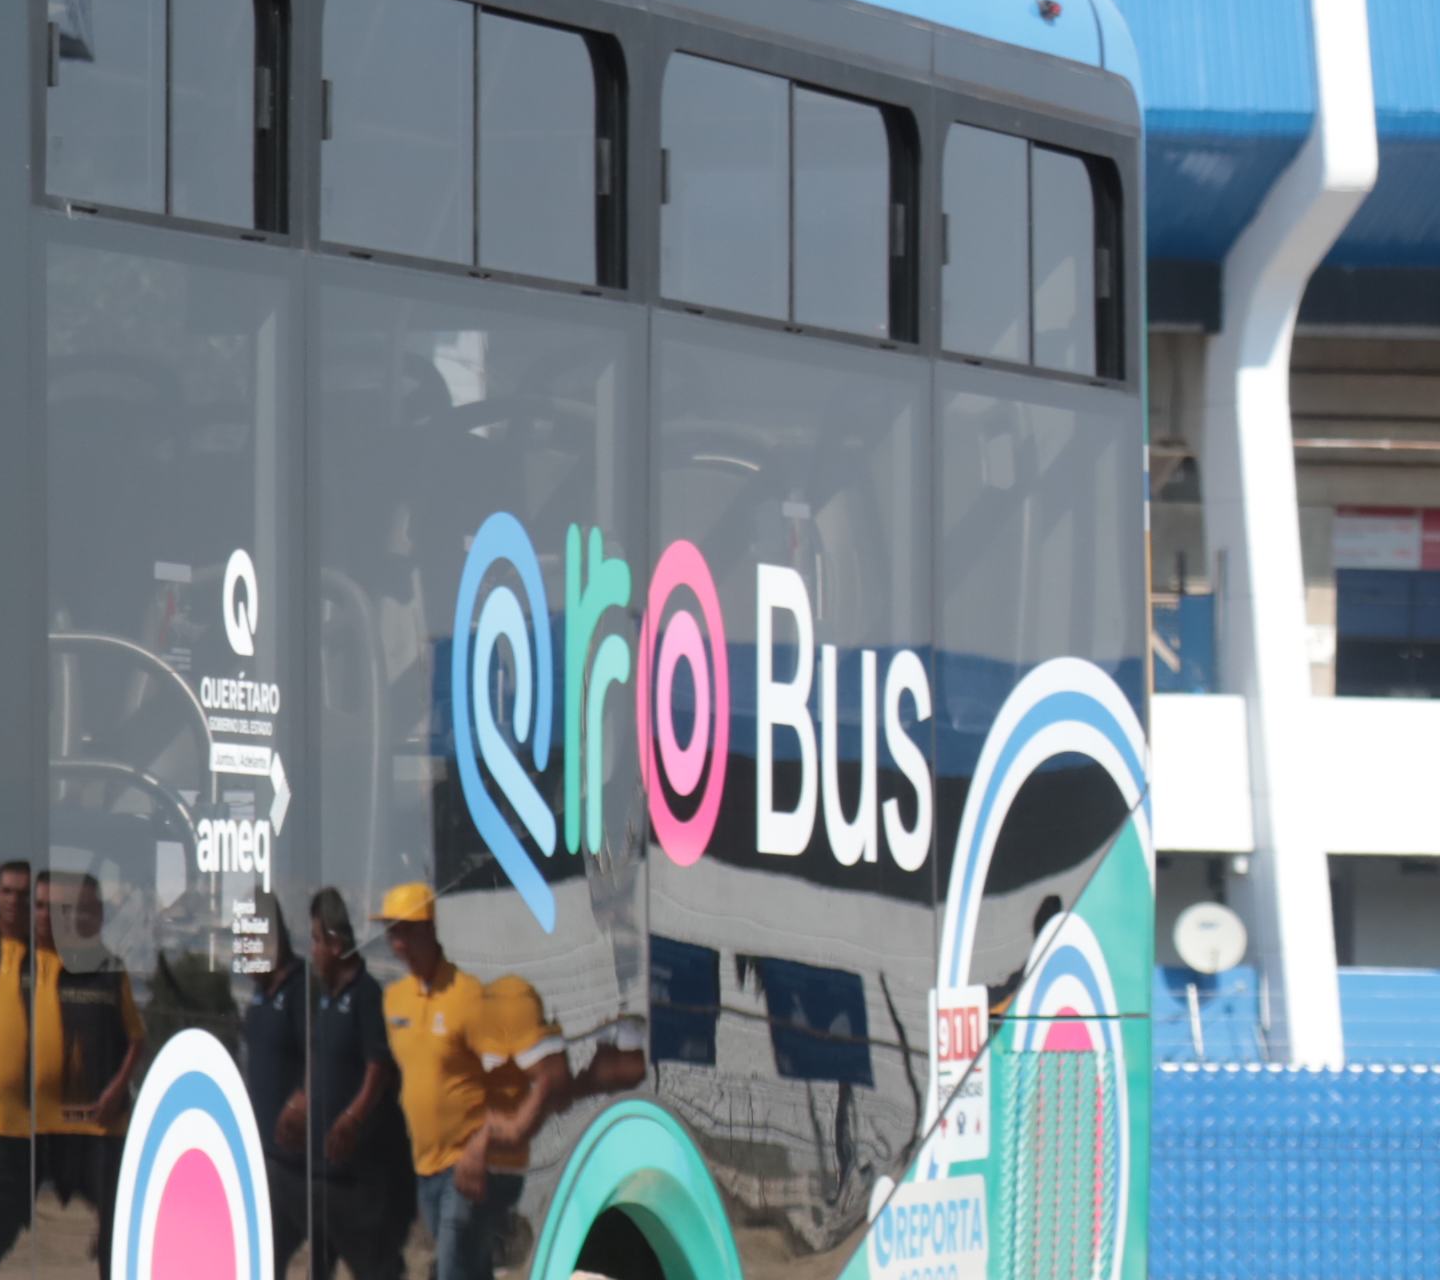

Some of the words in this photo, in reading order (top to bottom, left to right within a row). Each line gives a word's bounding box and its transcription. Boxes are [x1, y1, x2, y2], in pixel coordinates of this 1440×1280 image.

[200, 670, 281, 715] QUERÉTARO
[757, 562, 933, 872] Bus
[196, 818, 271, 894] ameq
[938, 1013, 979, 1059] 911
[895, 1198, 983, 1260] REPORTA
